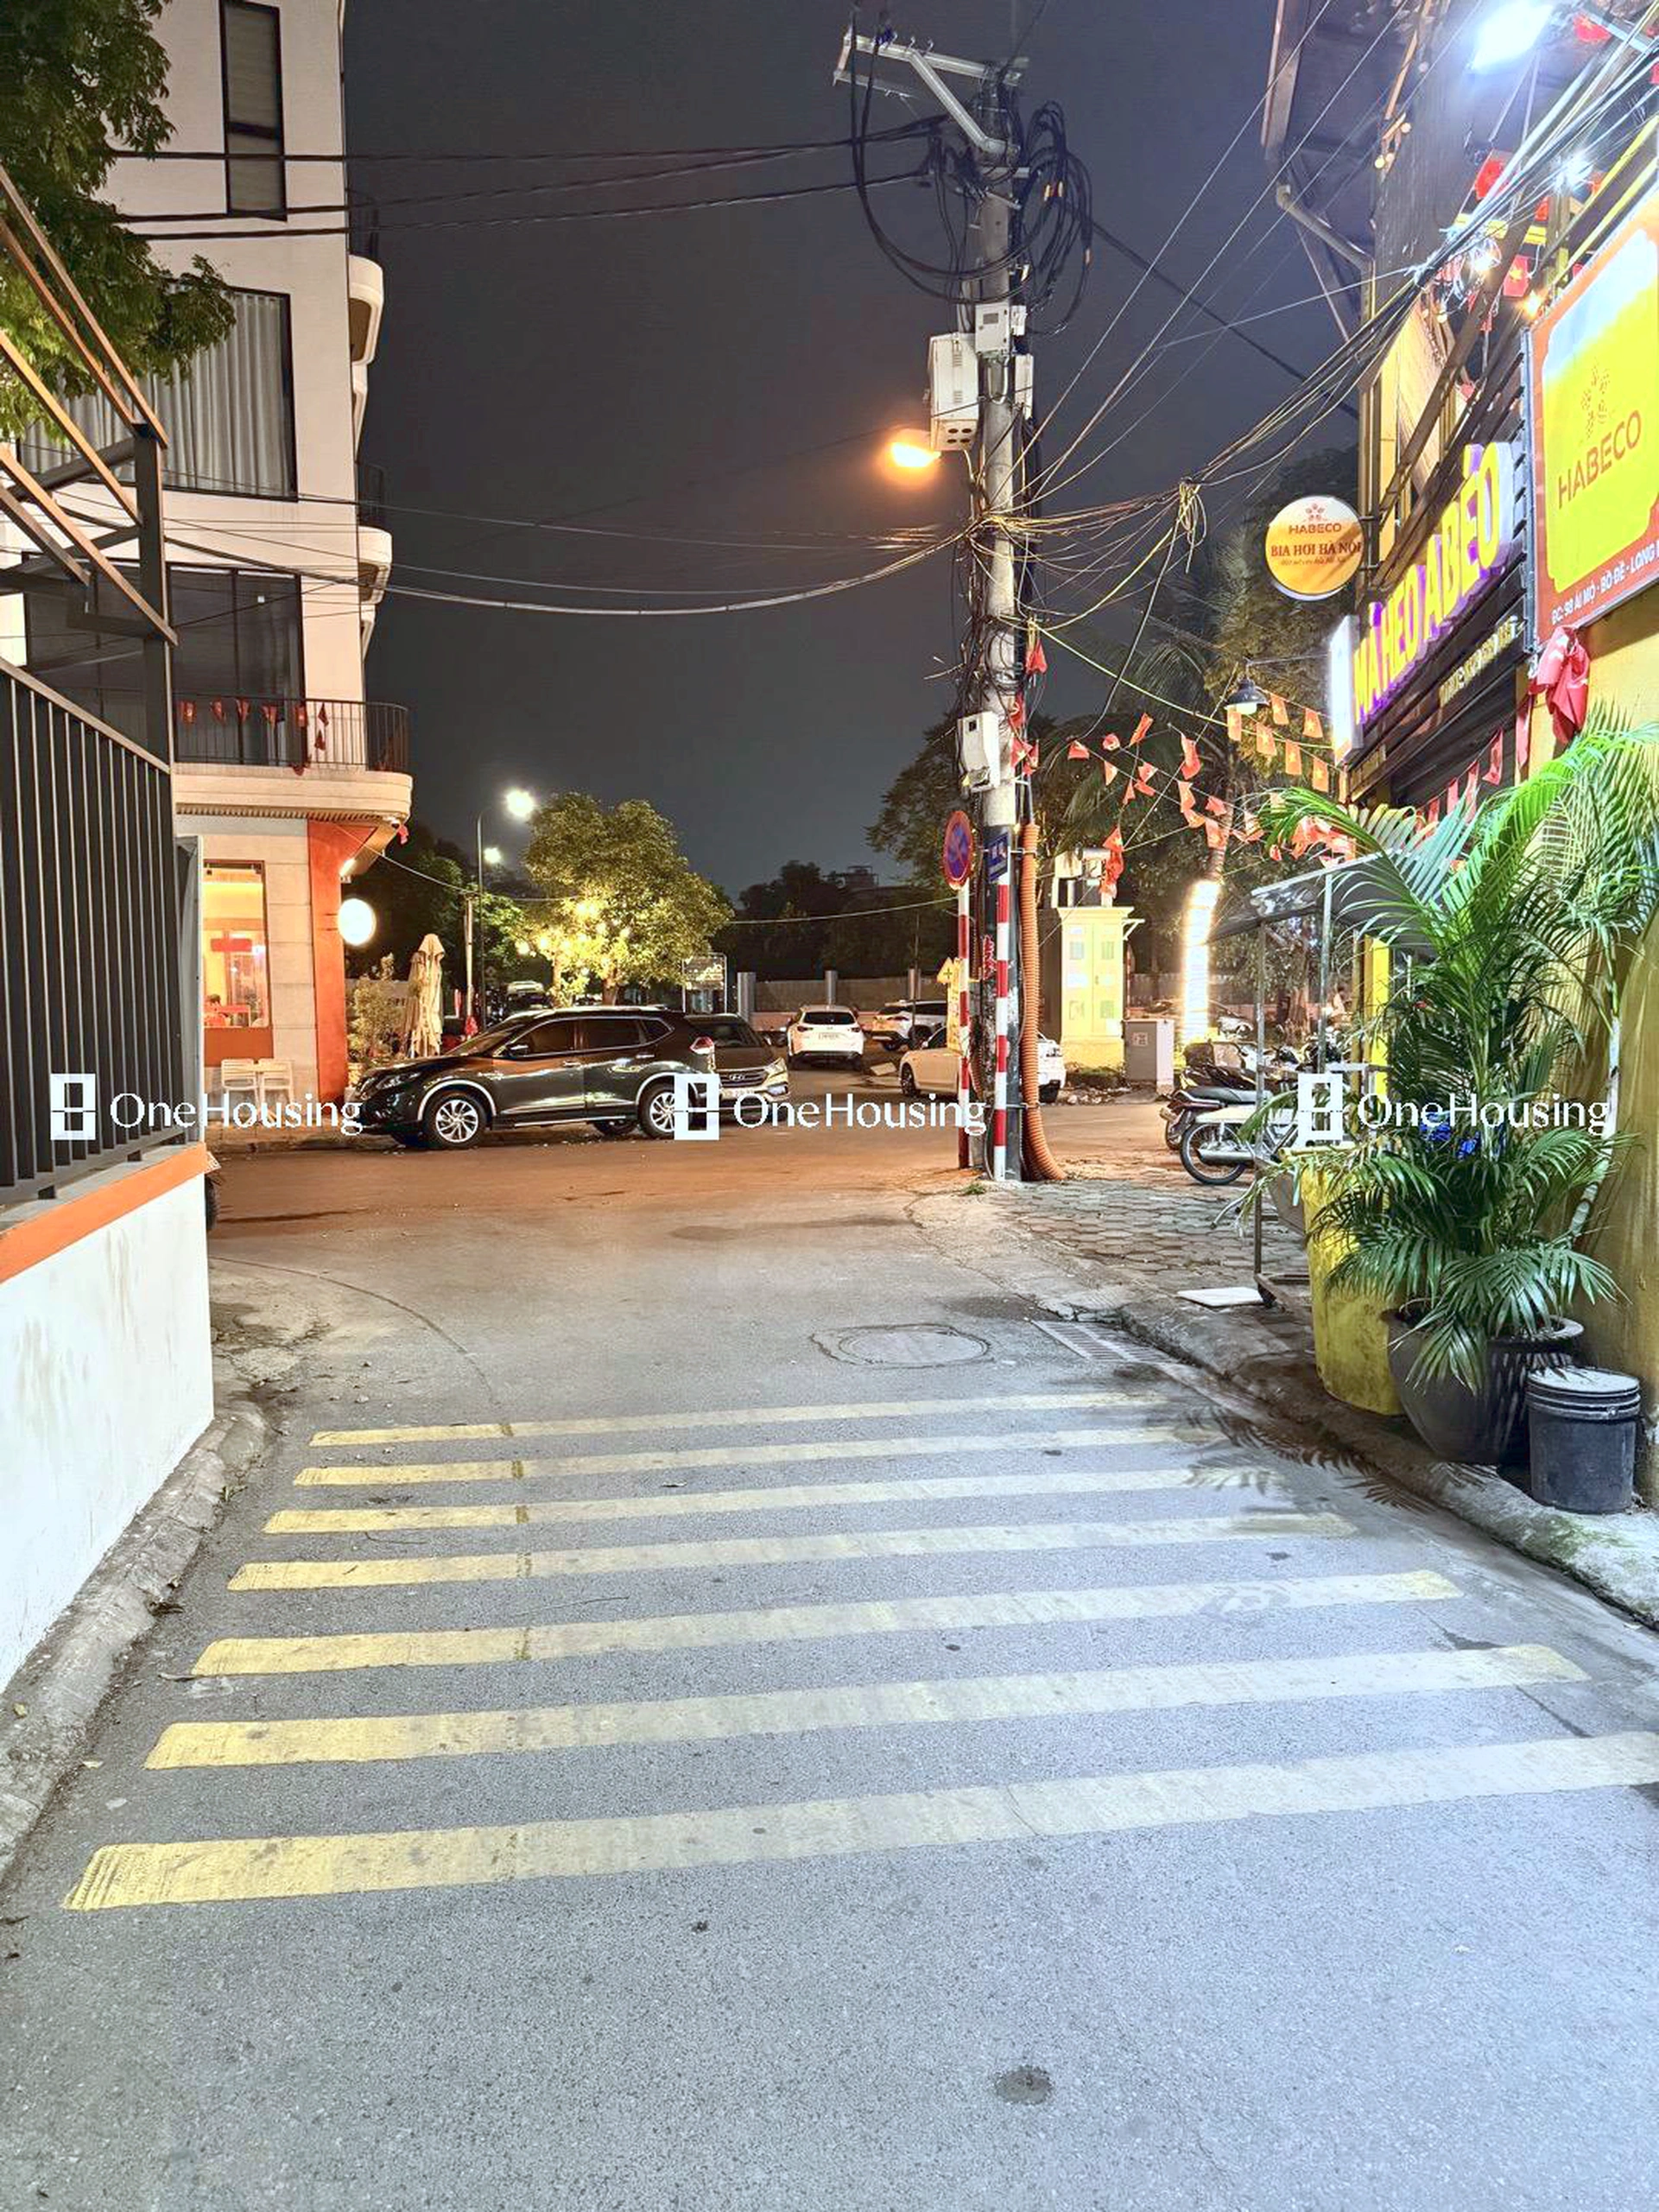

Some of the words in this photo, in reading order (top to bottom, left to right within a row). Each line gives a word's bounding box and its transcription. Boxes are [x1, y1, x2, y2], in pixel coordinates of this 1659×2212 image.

[1558, 409, 1642, 510] HABECO
[1288, 523, 1342, 535] HABECO
[1271, 544, 1290, 557] BIA
[1294, 542, 1315, 555] HƠI
[1319, 540, 1336, 555] HÀ
[1631, 542, 1656, 574] LONG
